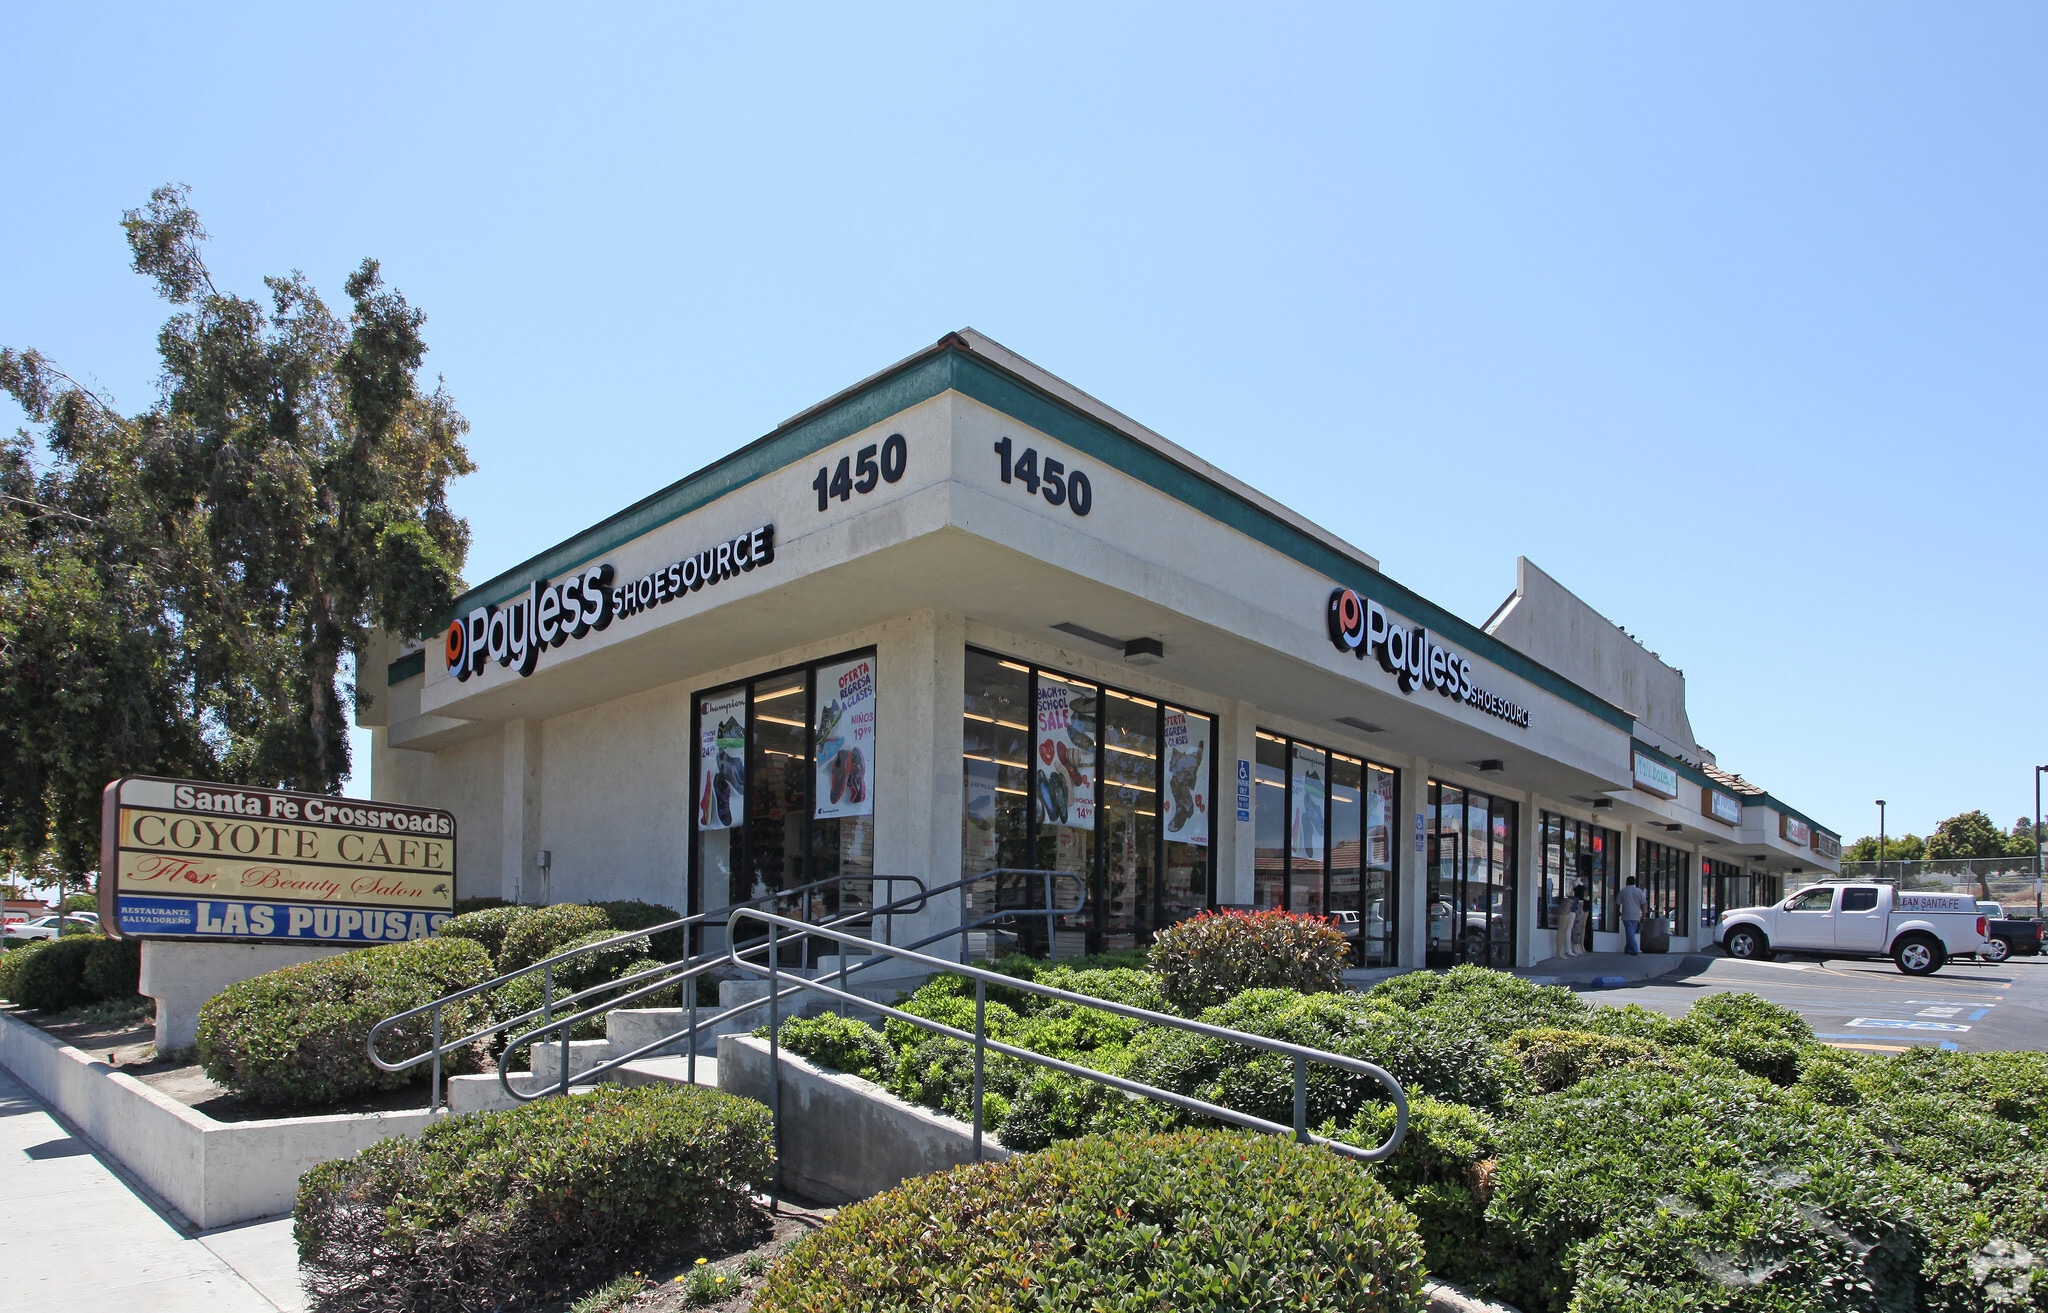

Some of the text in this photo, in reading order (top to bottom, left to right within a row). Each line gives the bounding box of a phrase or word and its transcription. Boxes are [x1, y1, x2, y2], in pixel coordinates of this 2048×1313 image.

[812, 433, 907, 512] 1450
[993, 436, 1093, 516] 1450
[467, 525, 771, 673] Payless SHOESOURCE
[838, 661, 870, 689] OFERTA
[1366, 598, 1533, 728] Payless SHOESOURCE
[840, 673, 871, 700] REGRESA
[841, 685, 873, 712] A CLASES
[1057, 688, 1068, 697] TO
[701, 699, 746, 715] Champion
[851, 711, 874, 725] NIÑOS
[1037, 697, 1068, 712] SCHOOL
[1038, 708, 1070, 732] SALE
[175, 786, 450, 835] Santa Fe Crossroads
[133, 815, 444, 869] COYOTE CAFE
[240, 866, 342, 899] Beauty
[350, 874, 425, 899] Salon
[121, 906, 190, 917] RESTAURANTE
[1920, 898, 1947, 909] SANTA
[1948, 899, 1960, 909] FE
[121, 914, 191, 925] SALVADOREÑO
[196, 901, 275, 936] LAS
